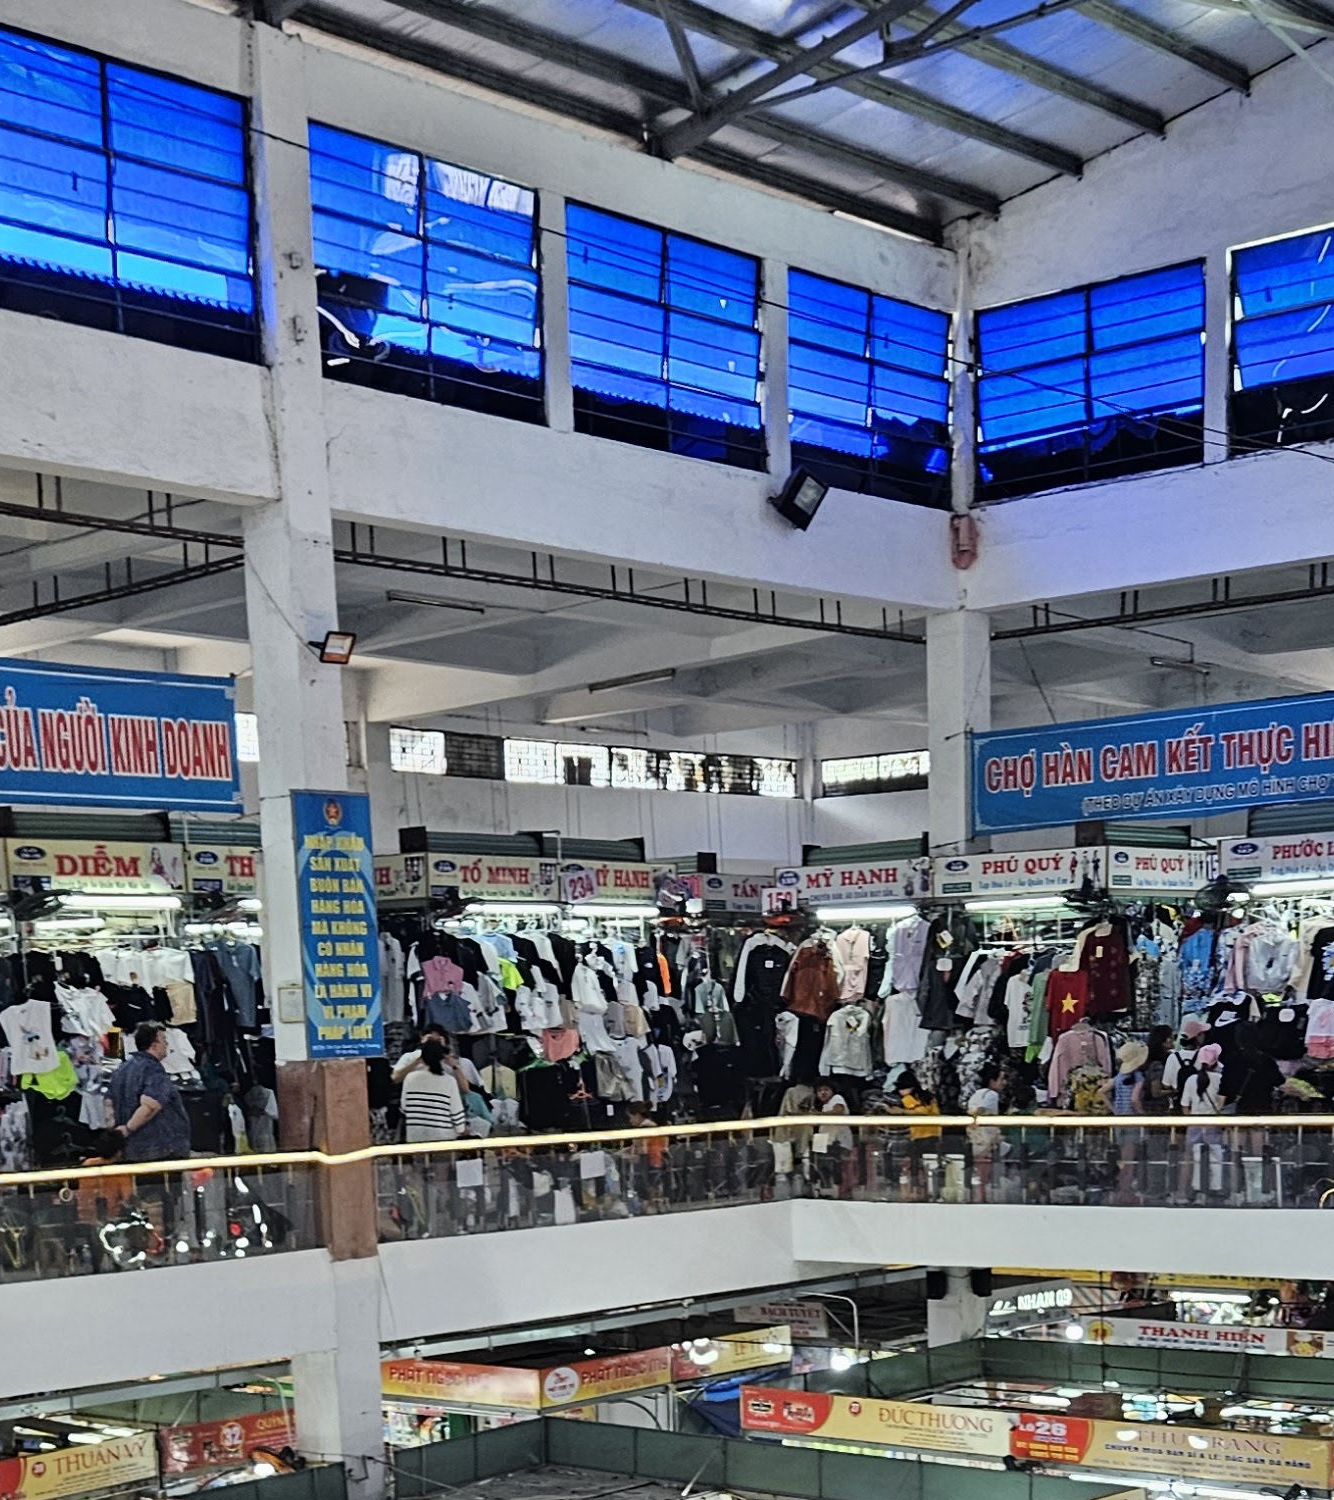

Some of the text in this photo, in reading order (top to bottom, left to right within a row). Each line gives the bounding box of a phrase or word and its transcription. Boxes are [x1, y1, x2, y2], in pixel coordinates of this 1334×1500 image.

[38, 696, 108, 775] NGƯỜI
[108, 714, 161, 778] KINH
[161, 719, 232, 782] DOANH
[984, 749, 1035, 797] CHỢ
[1043, 742, 1094, 788] HÀN
[1100, 741, 1157, 781] CAM
[1166, 723, 1214, 774] KẾT
[1220, 721, 1294, 774] THỰC
[54, 845, 141, 878] DIỄM
[982, 854, 1017, 875] PHÚ
[487, 866, 530, 885] MINH
[1035, 1422, 1067, 1435] 26
